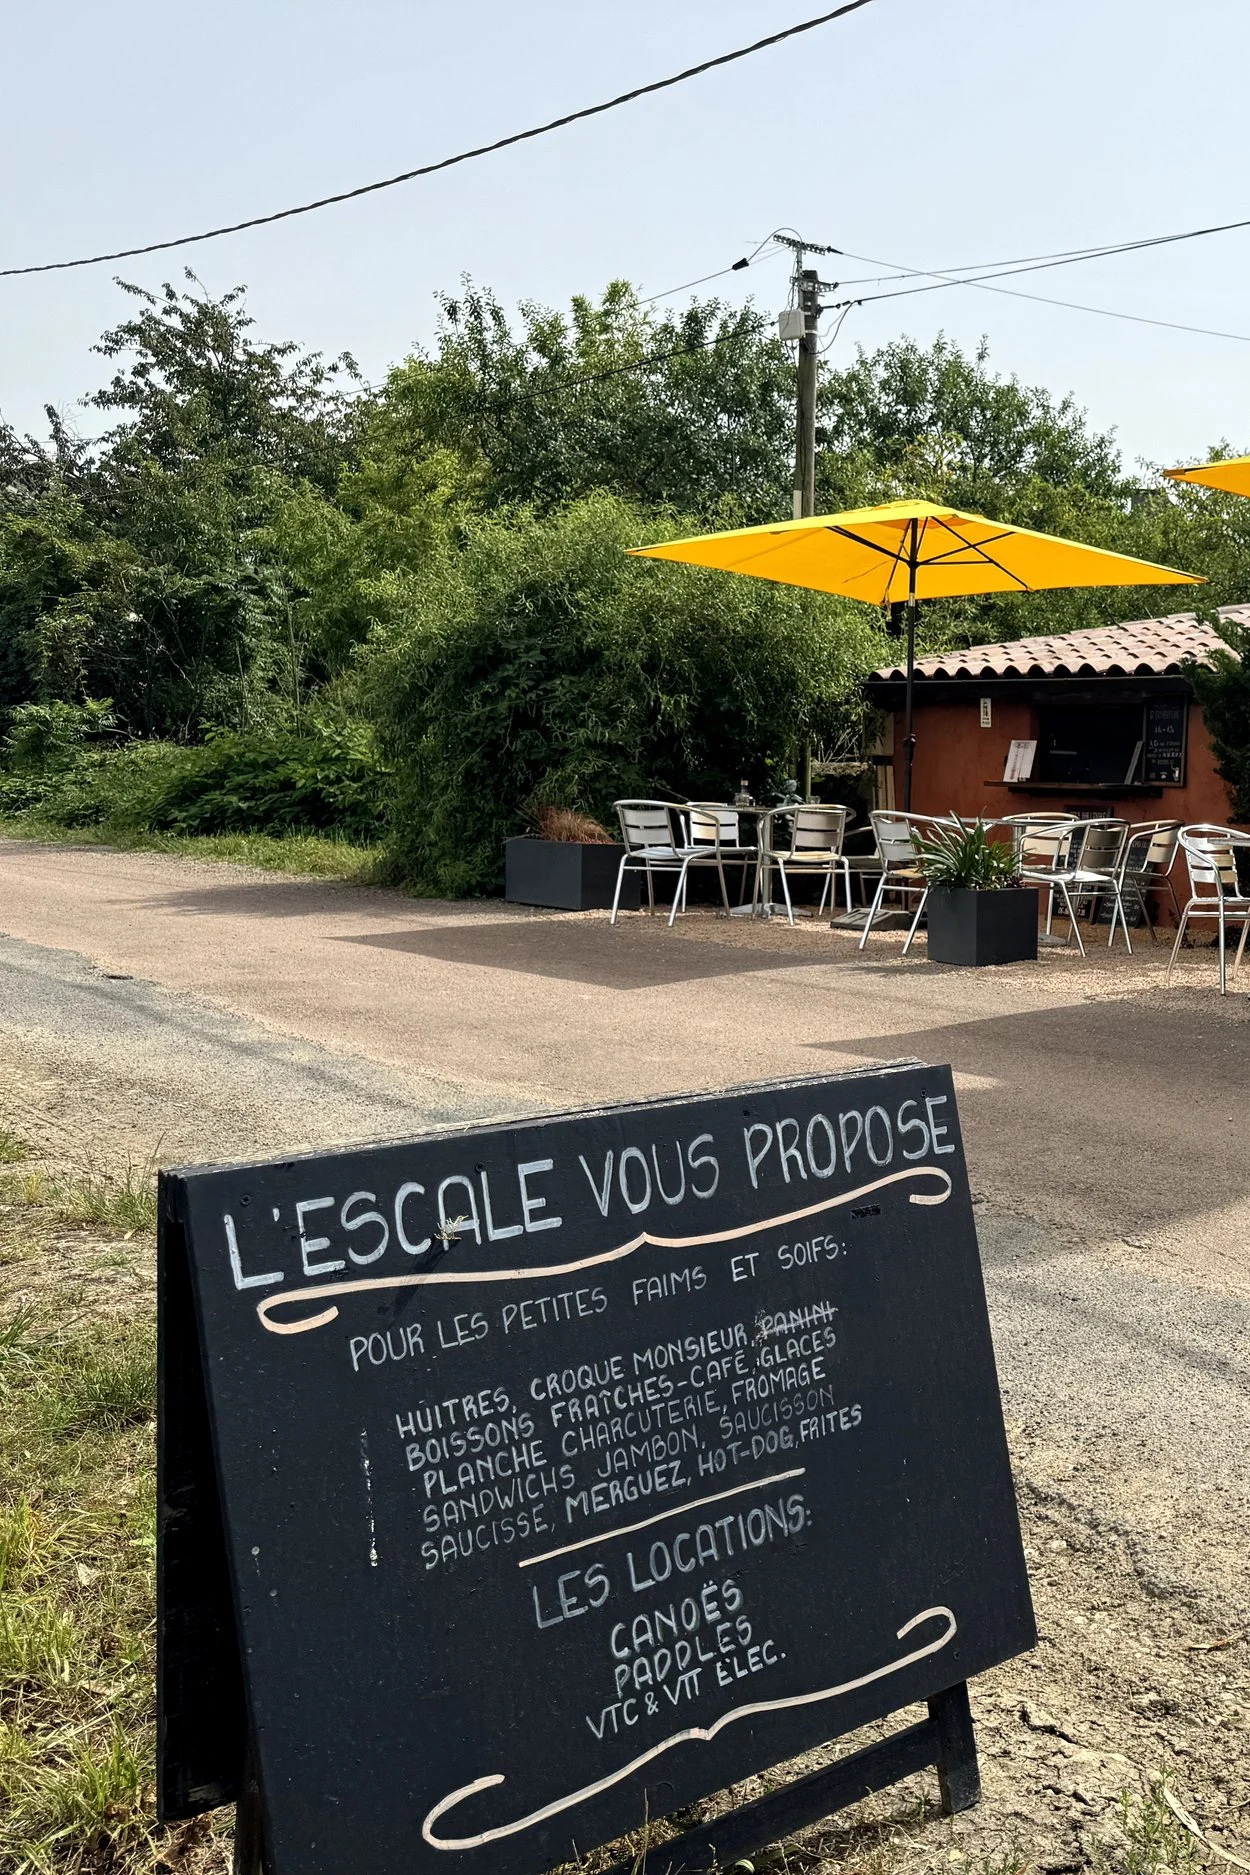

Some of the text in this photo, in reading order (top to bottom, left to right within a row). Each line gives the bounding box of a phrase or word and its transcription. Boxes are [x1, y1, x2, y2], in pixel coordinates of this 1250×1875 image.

[224, 1096, 956, 1290] L'ESCALE VOUS PROPOSE
[349, 1234, 848, 1371] POUR LES PETITES FAIMS ET SOIFS:
[395, 1387, 517, 1439] HUITRES,
[530, 1356, 625, 1401] CROQUE
[405, 1412, 535, 1471] BOISSONS
[423, 1356, 826, 1498] PLANCHE CHARCUTERIE, FROMAGE
[422, 1384, 835, 1532] SANDWICHS JAMBON, SAUCISSON
[421, 1503, 555, 1570] SAUCISSE,
[565, 1460, 692, 1523] MERGUEZ,
[532, 1494, 813, 1629] LES LOCATIONS:
[611, 1579, 743, 1659] CANOËS
[614, 1614, 752, 1699] PADDLES
[585, 1698, 639, 1738] VTC
[644, 1691, 660, 1716] &
[663, 1668, 703, 1706] VTT
